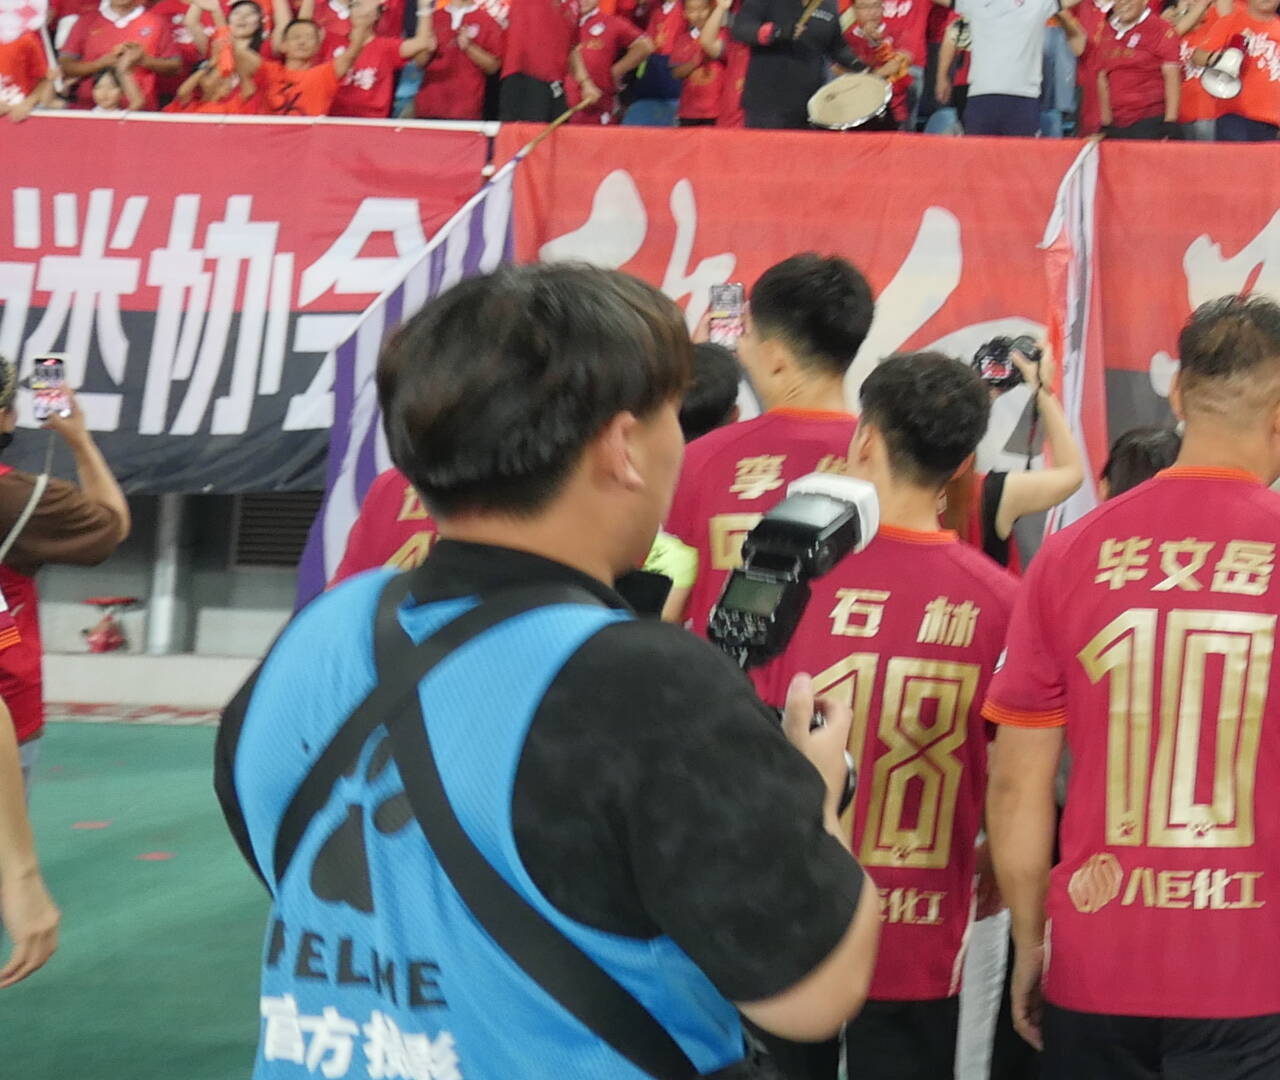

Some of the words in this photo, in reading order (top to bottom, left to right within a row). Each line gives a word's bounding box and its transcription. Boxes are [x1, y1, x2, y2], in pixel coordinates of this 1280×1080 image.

[828, 587, 980, 648] 石林
[1094, 536, 1277, 596] 毕文岳
[810, 652, 981, 870] 18
[1076, 607, 1278, 848] 10
